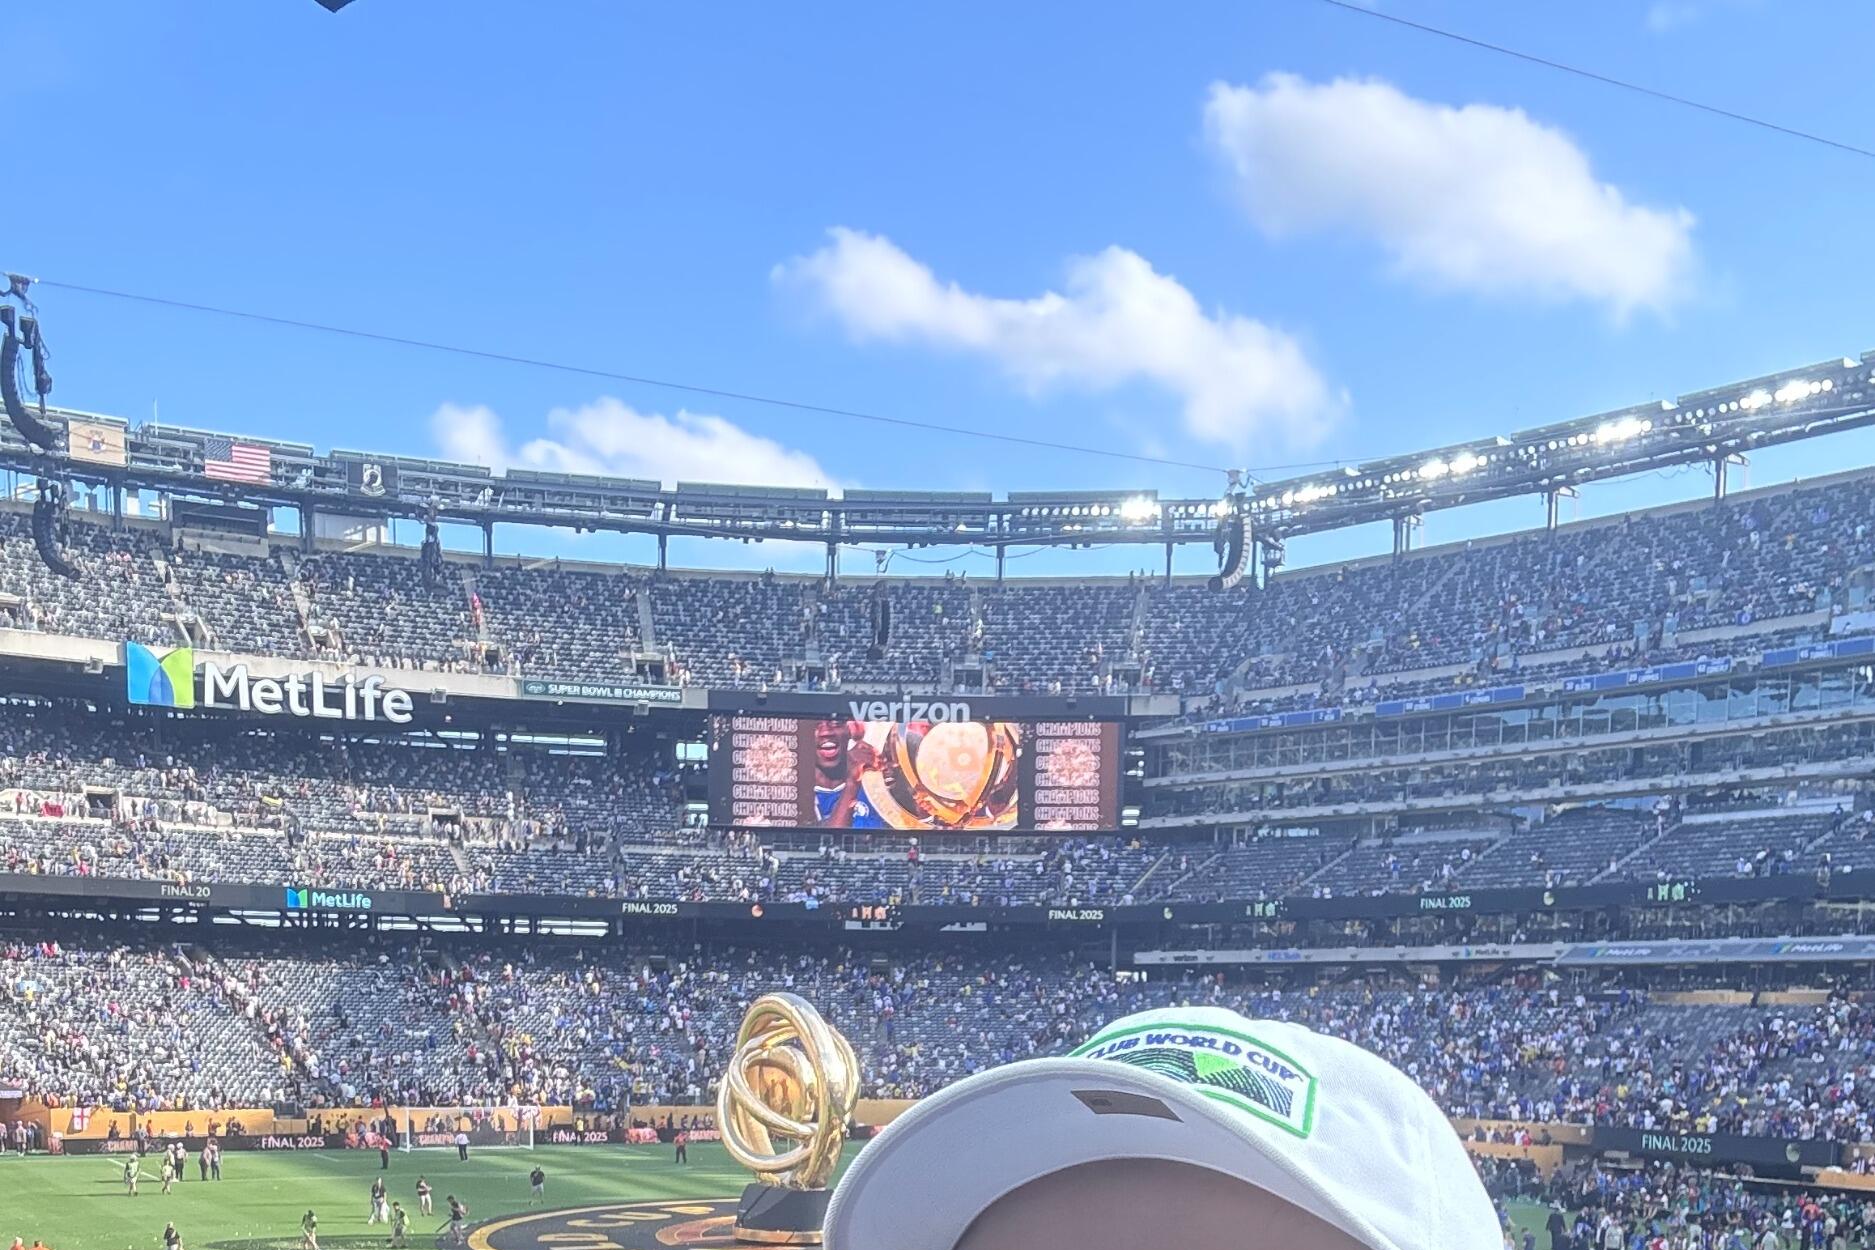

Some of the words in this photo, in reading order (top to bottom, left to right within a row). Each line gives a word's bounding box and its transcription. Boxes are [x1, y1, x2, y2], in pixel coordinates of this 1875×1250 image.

[203, 662, 414, 723] MetLife
[549, 683, 580, 695] SUPER
[582, 686, 613, 697] BOWL
[623, 690, 681, 701] CHAMPIONS
[848, 694, 971, 724] verizon
[732, 716, 798, 732] CHAMPIONS
[1036, 722, 1101, 736] CHAMPIONS
[732, 785, 798, 800] CHAMPIONS
[1035, 789, 1100, 804] CHAMPIONS
[161, 885, 194, 896] FINAL
[196, 887, 210, 897] 20
[312, 892, 372, 909] MetLife
[622, 902, 651, 913] FINAL
[654, 904, 678, 914] 2025
[1420, 898, 1446, 909] FINAL
[1449, 896, 1471, 908] 2025
[1049, 910, 1078, 920] FINAL
[1080, 910, 1103, 920] 2025
[1146, 1034, 1242, 1056] WORLD
[1246, 1051, 1297, 1081] CUP
[261, 1136, 296, 1150] FINAL
[297, 1136, 325, 1148] 2025
[584, 1131, 608, 1142] 2025
[1641, 1134, 1678, 1151] FINAL
[1681, 1137, 1712, 1154] 2025
